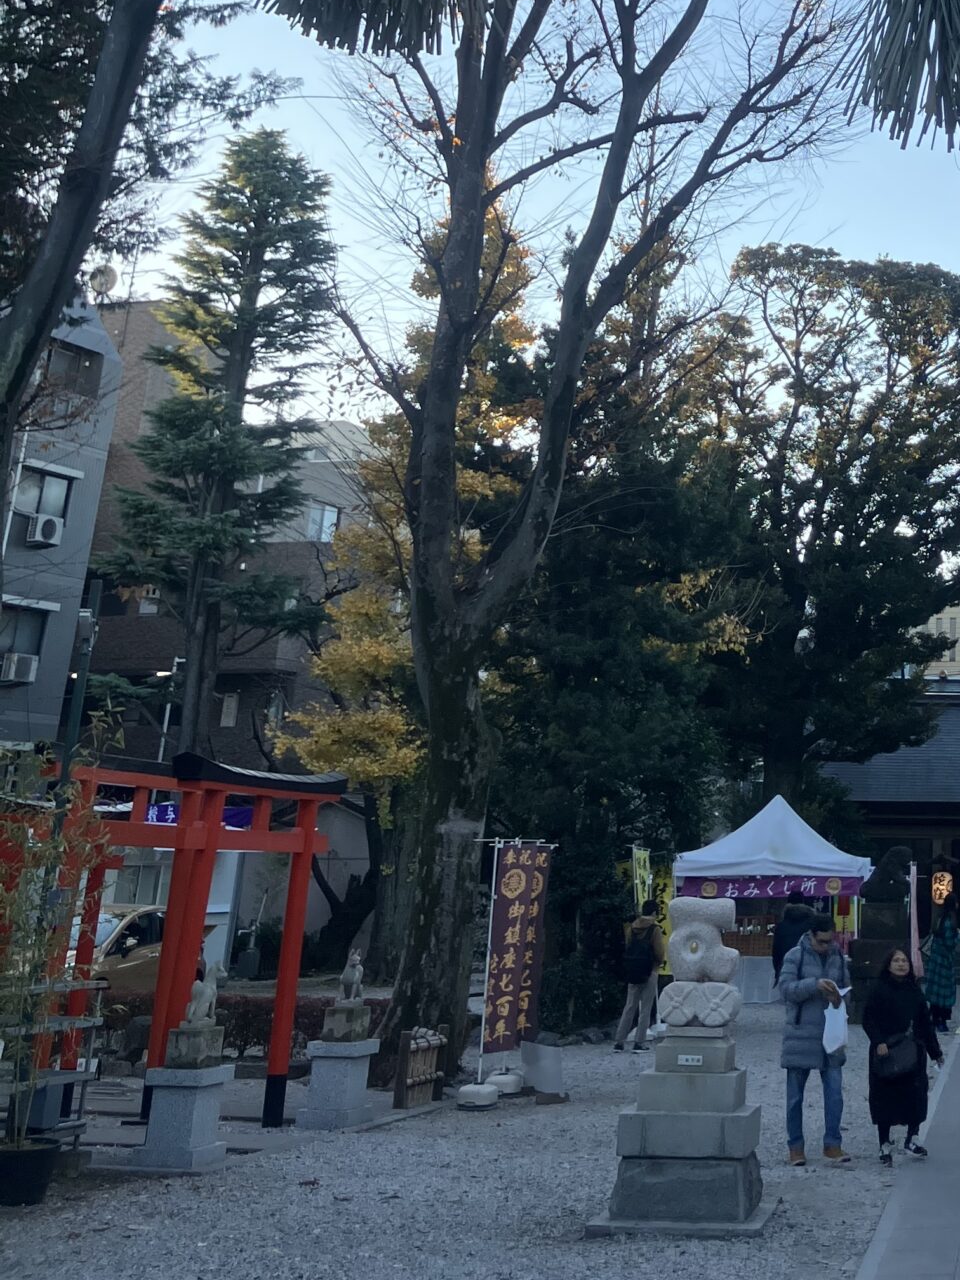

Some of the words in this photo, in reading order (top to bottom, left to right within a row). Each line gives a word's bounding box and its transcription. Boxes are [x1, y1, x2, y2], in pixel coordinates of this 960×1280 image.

[724, 877, 817, 898] おみくじ所
[492, 900, 526, 1044] 御鎮座七百年
